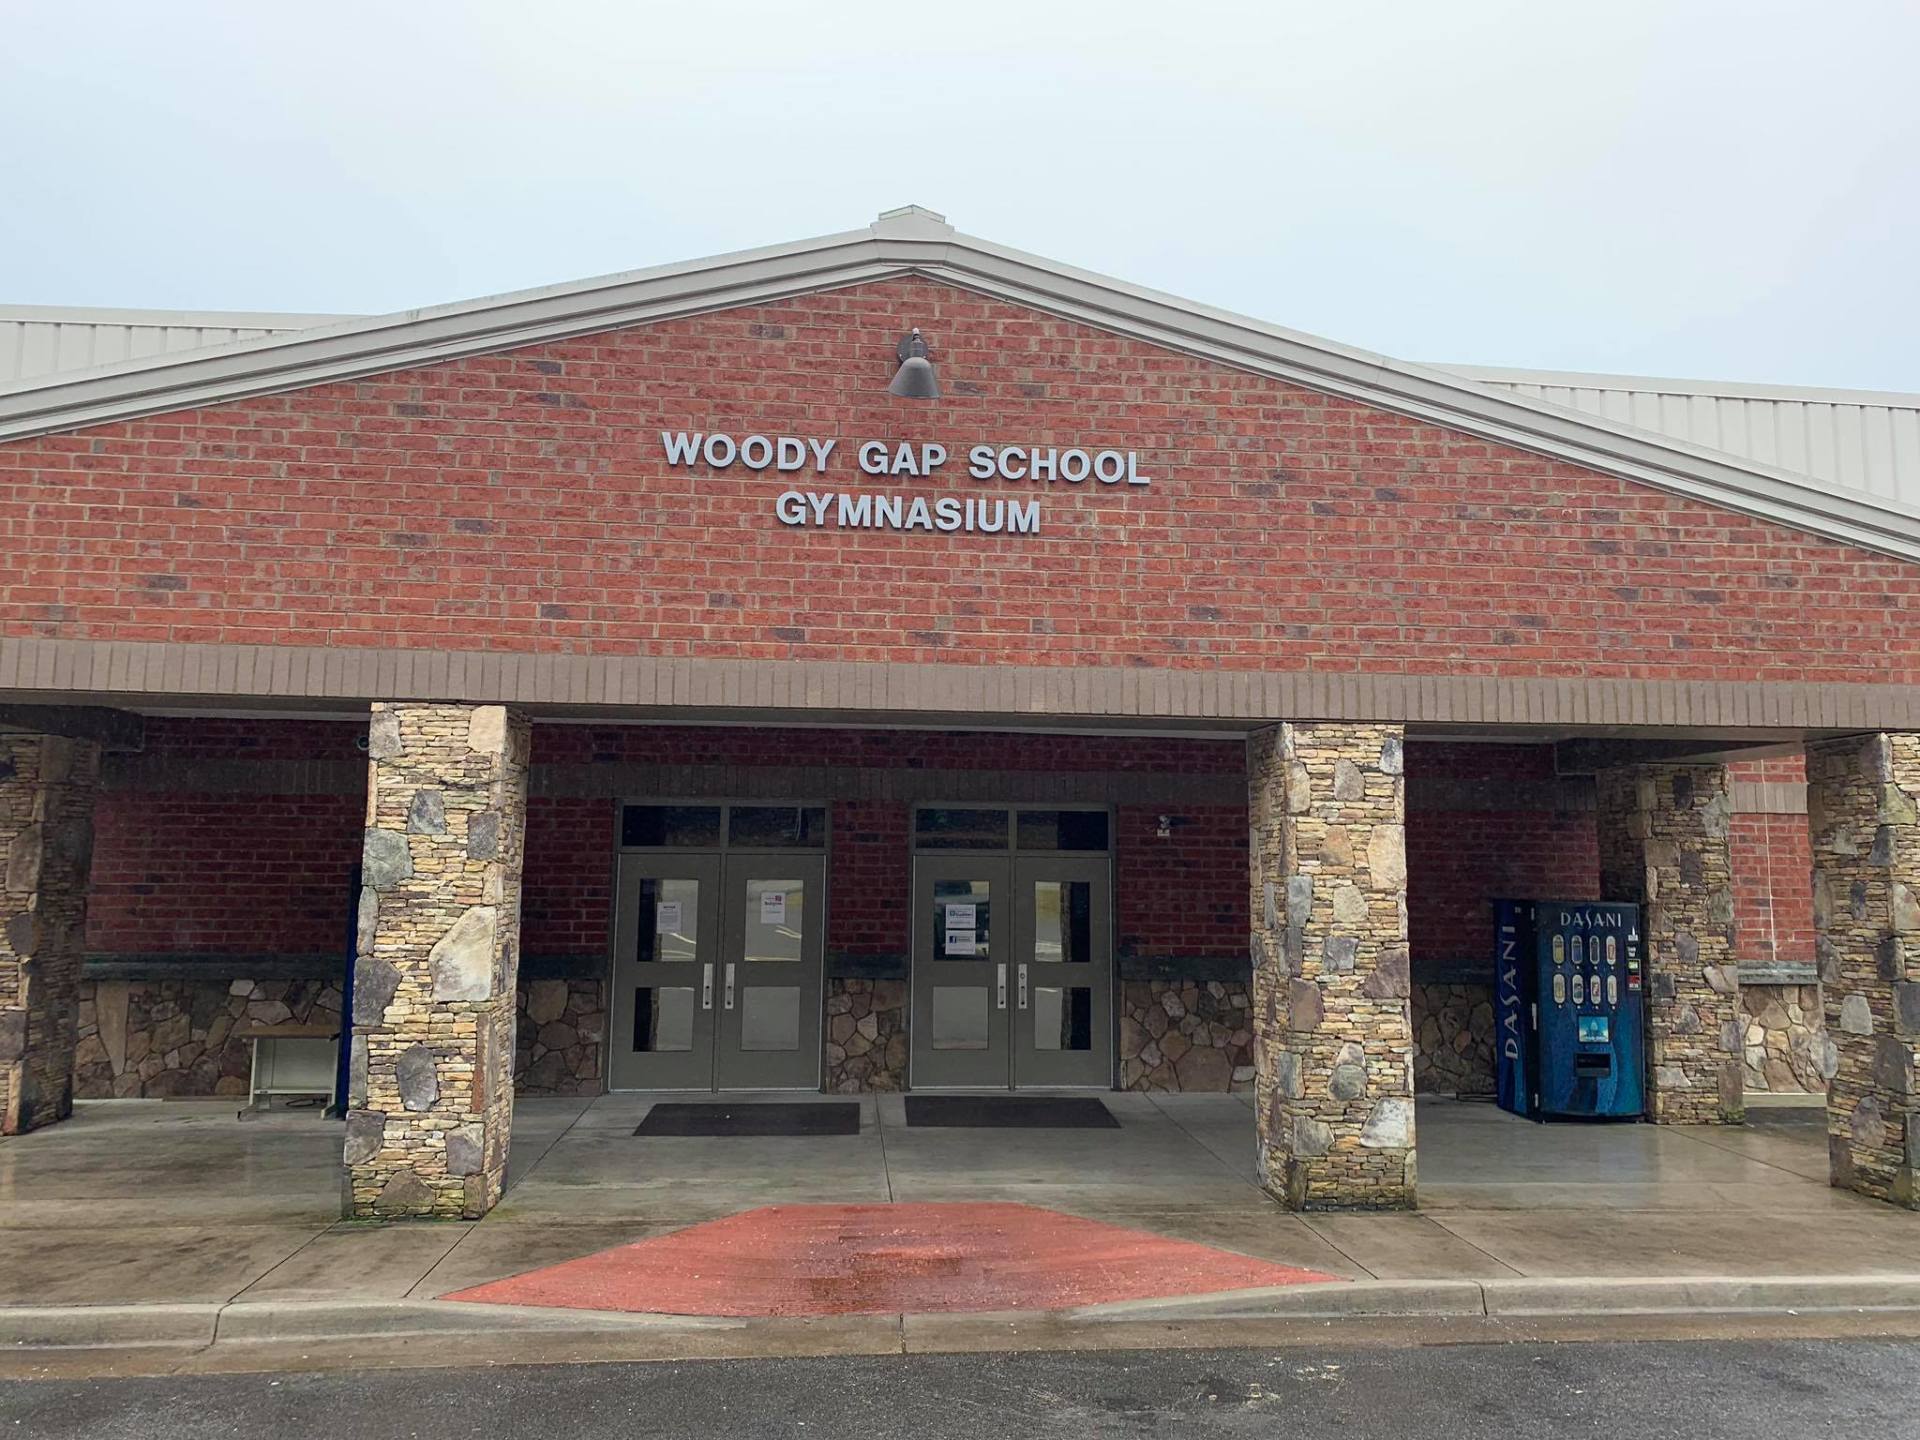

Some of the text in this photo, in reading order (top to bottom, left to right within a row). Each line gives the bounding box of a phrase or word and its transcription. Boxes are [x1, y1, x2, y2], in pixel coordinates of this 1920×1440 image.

[661, 431, 1151, 485] WOODY GAP SCHOOL
[775, 490, 1041, 534] GYMNASIUM
[1560, 911, 1622, 929] DASANI
[1501, 926, 1521, 1060] DASANI
